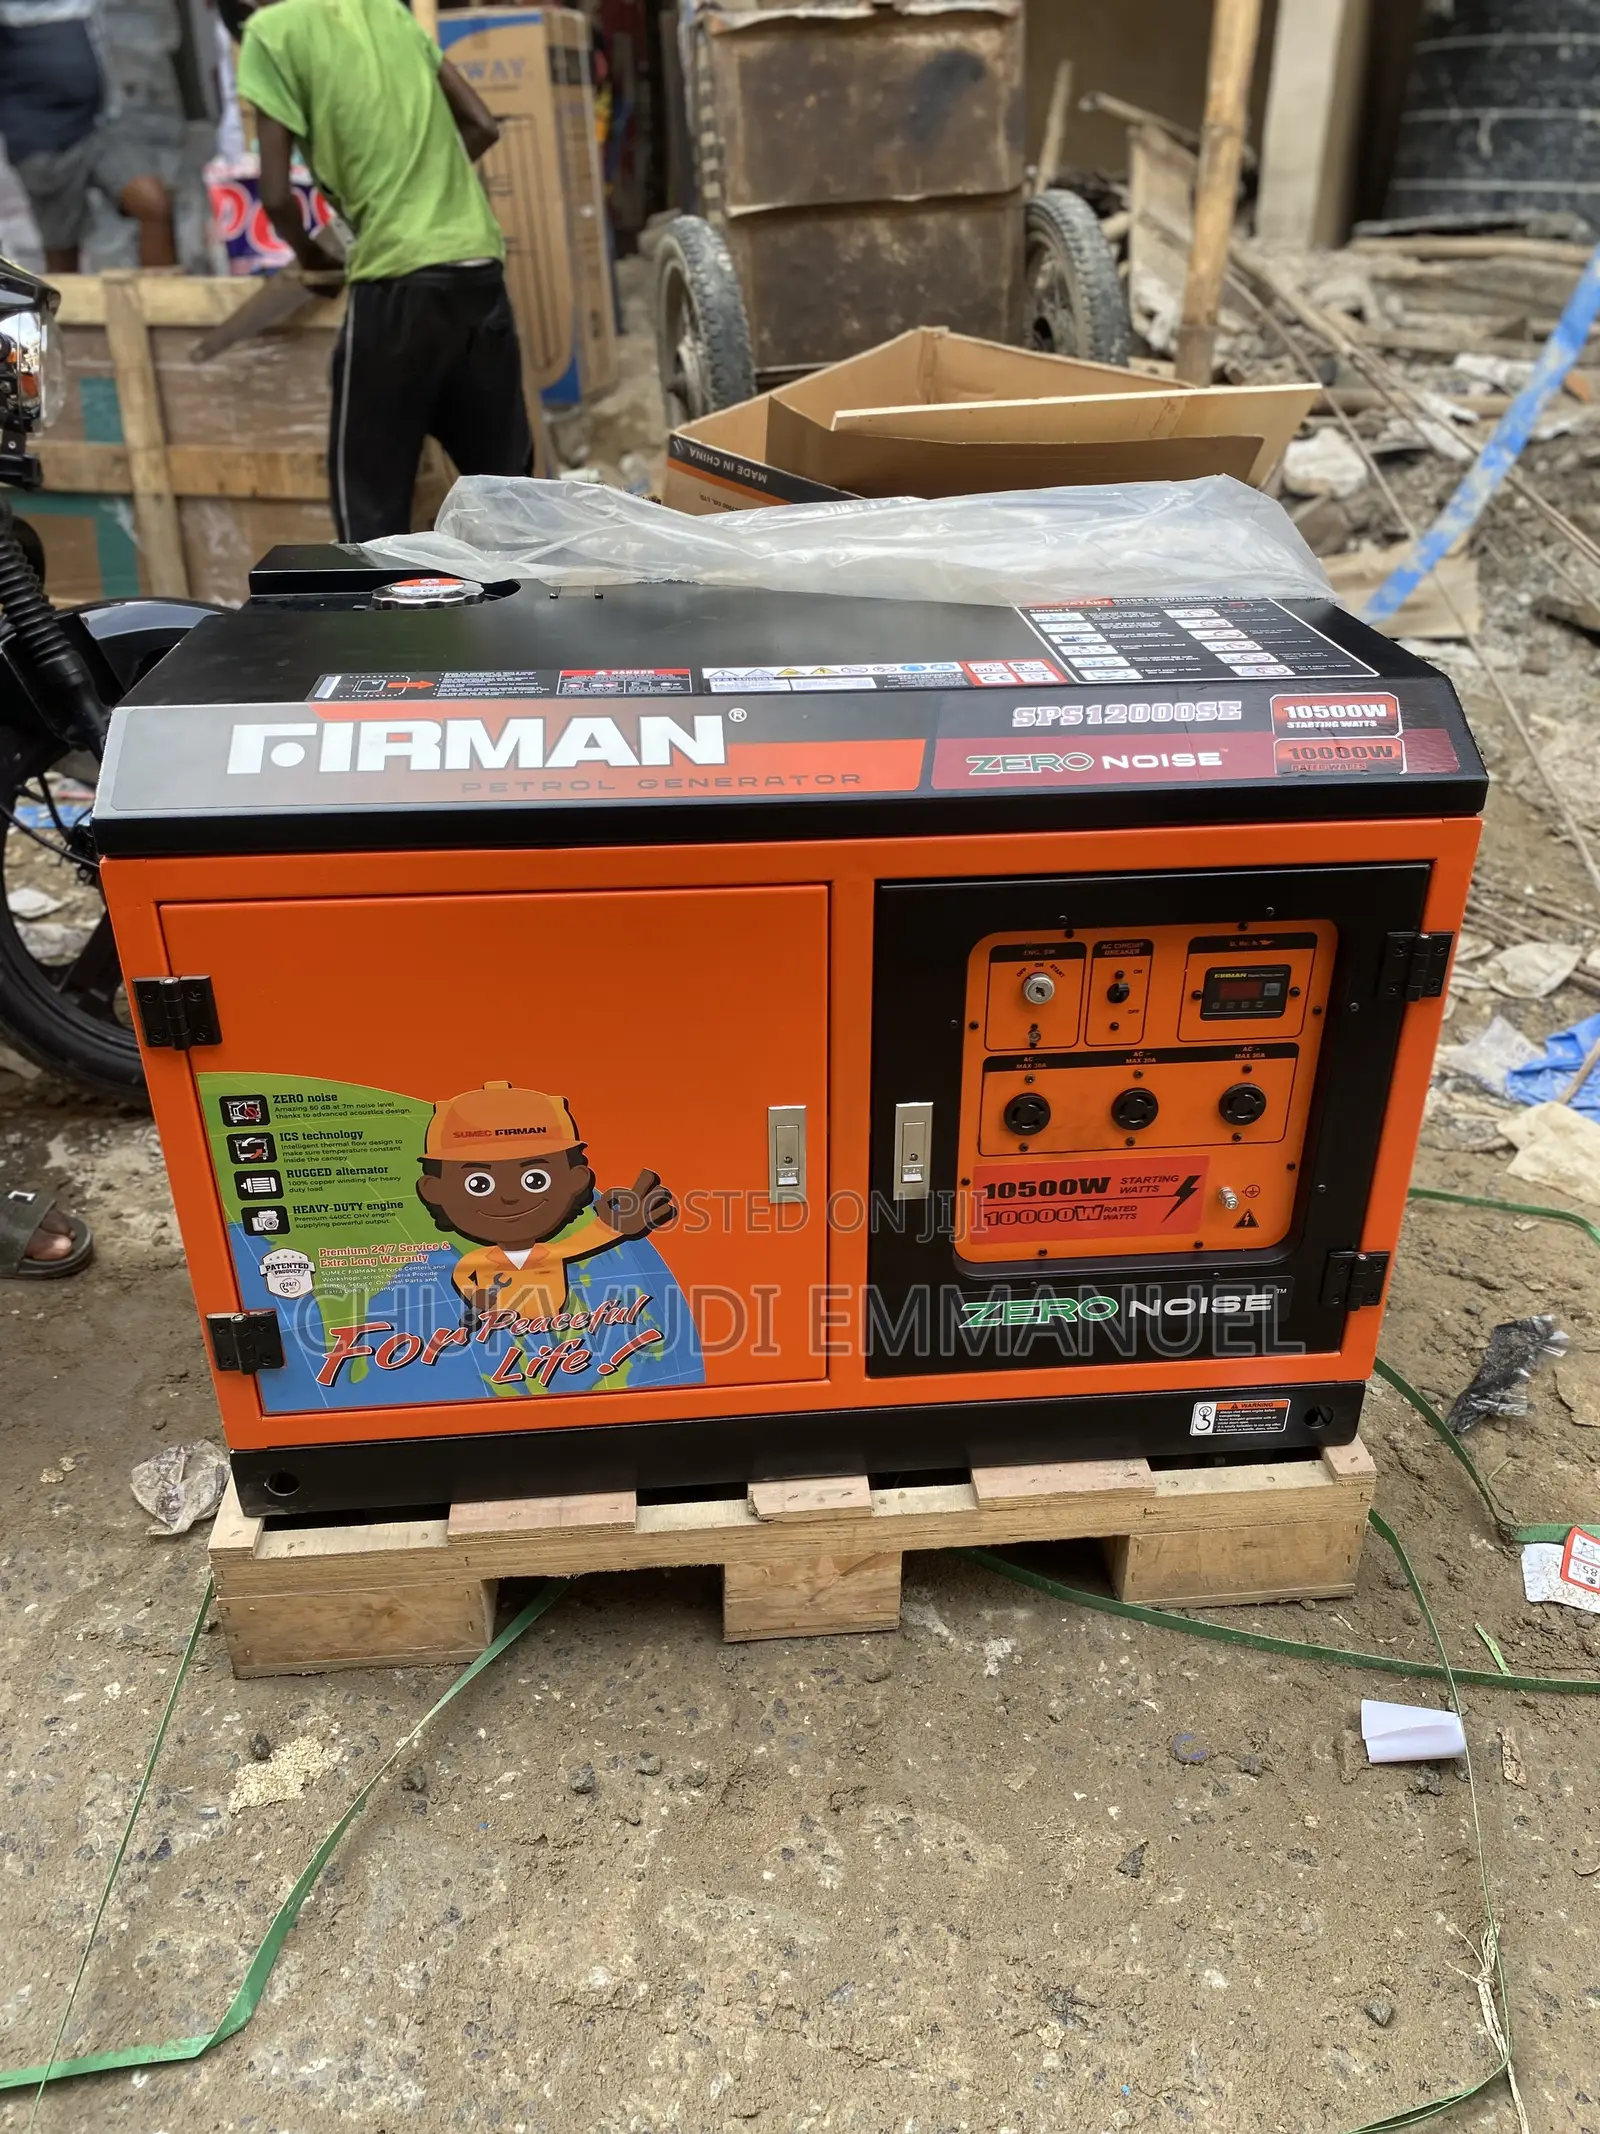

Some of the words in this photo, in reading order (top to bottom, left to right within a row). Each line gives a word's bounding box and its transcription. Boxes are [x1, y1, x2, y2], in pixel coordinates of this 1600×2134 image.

[460, 57, 527, 80] WAY
[689, 447, 721, 467] CHINA
[723, 462, 735, 473] IN
[736, 464, 768, 484] MADE
[1011, 701, 1243, 728] SPS12000SE
[1283, 703, 1388, 719] 10500W
[1286, 720, 1340, 729] STARTING
[1340, 719, 1377, 728] WATTS
[1288, 745, 1394, 760] 10000W
[965, 752, 1095, 776] ZERO
[1101, 752, 1223, 770] NOISE
[461, 779, 617, 794] PETROL
[637, 774, 861, 790] GENERATOR
[1050, 964, 1066, 978] START
[272, 1094, 304, 1104] ZERO
[307, 1092, 338, 1102] noise
[385, 1107, 412, 1115] design.
[279, 1132, 299, 1142] ICS
[302, 1130, 363, 1141] technology
[453, 1129, 492, 1138] SUMEC
[494, 1126, 547, 1137] FIRMAN
[281, 1142, 319, 1150] Intelligent
[368, 1139, 393, 1147] design
[321, 1146, 368, 1156] temperature
[321, 1155, 348, 1163] canopy
[286, 1167, 332, 1179] RUGGED
[335, 1166, 389, 1176] alternator
[982, 1177, 1112, 1200] 10500W
[1119, 1175, 1179, 1185] STARTING
[1119, 1184, 1160, 1194] WATTS
[292, 1202, 364, 1215] HEAVY-DUTY
[366, 1201, 404, 1212] engine
[983, 1204, 1105, 1226] 10000W
[1103, 1205, 1138, 1213] RATED
[1103, 1212, 1138, 1221] WATTS
[331, 1220, 364, 1228] powerful
[318, 1247, 369, 1258] Premium
[371, 1244, 396, 1254] 24/7
[399, 1242, 439, 1253] Service
[441, 1241, 451, 1251] &
[265, 1262, 309, 1272] PATENTED
[319, 1258, 348, 1268] Extra
[350, 1256, 377, 1267] Long
[379, 1253, 429, 1265] Warranty
[322, 1275, 361, 1283] Workshops
[375, 1278, 404, 1286] Original
[363, 1285, 395, 1293] Warranty
[958, 1295, 1119, 1329] ZERO
[1128, 1292, 1274, 1317] NOISE
[315, 1321, 471, 1387] For
[474, 1294, 655, 1344] Peaceful
[490, 1327, 665, 1388] Life!
